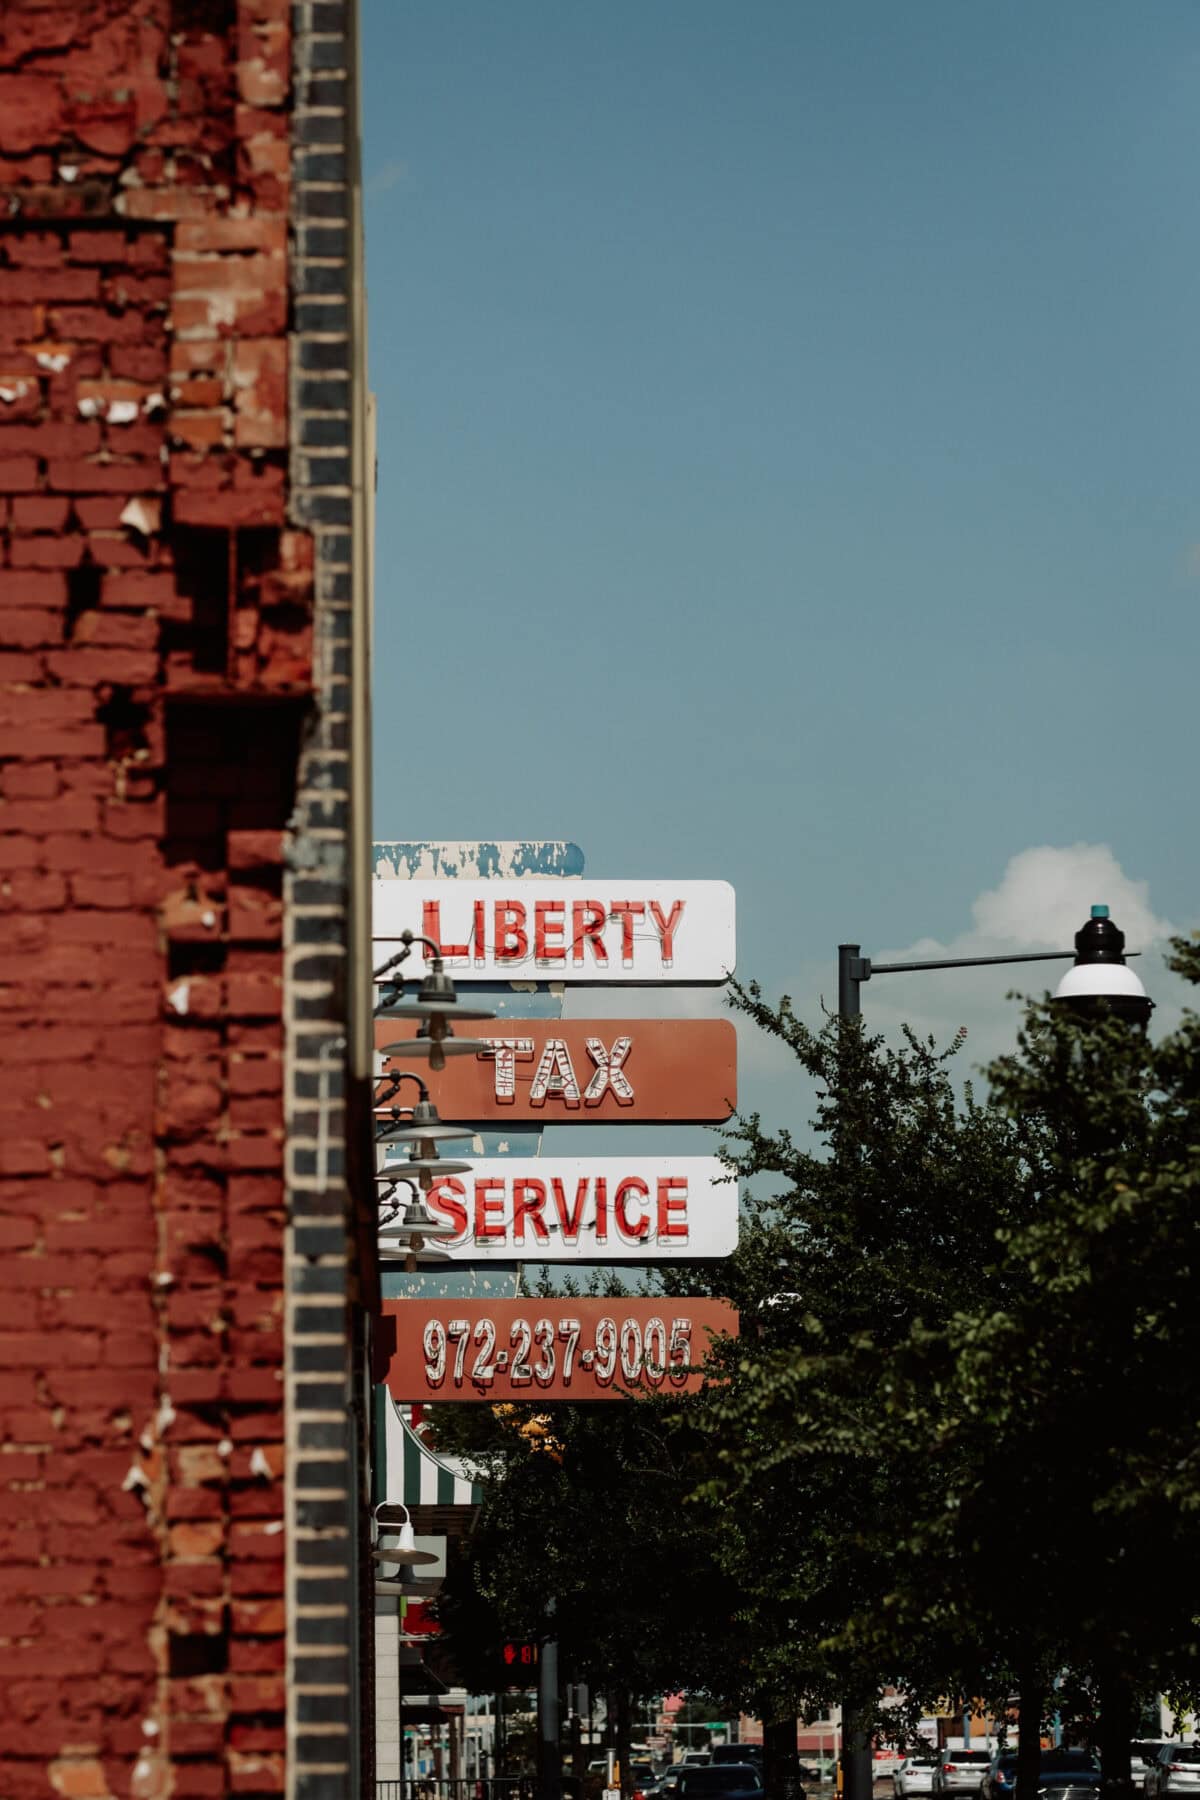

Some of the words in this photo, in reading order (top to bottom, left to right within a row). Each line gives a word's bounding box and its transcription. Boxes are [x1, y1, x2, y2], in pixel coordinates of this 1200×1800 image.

[422, 900, 686, 968] LIBERTY
[477, 1037, 634, 1099] TAX
[426, 1176, 688, 1246] SERVICE
